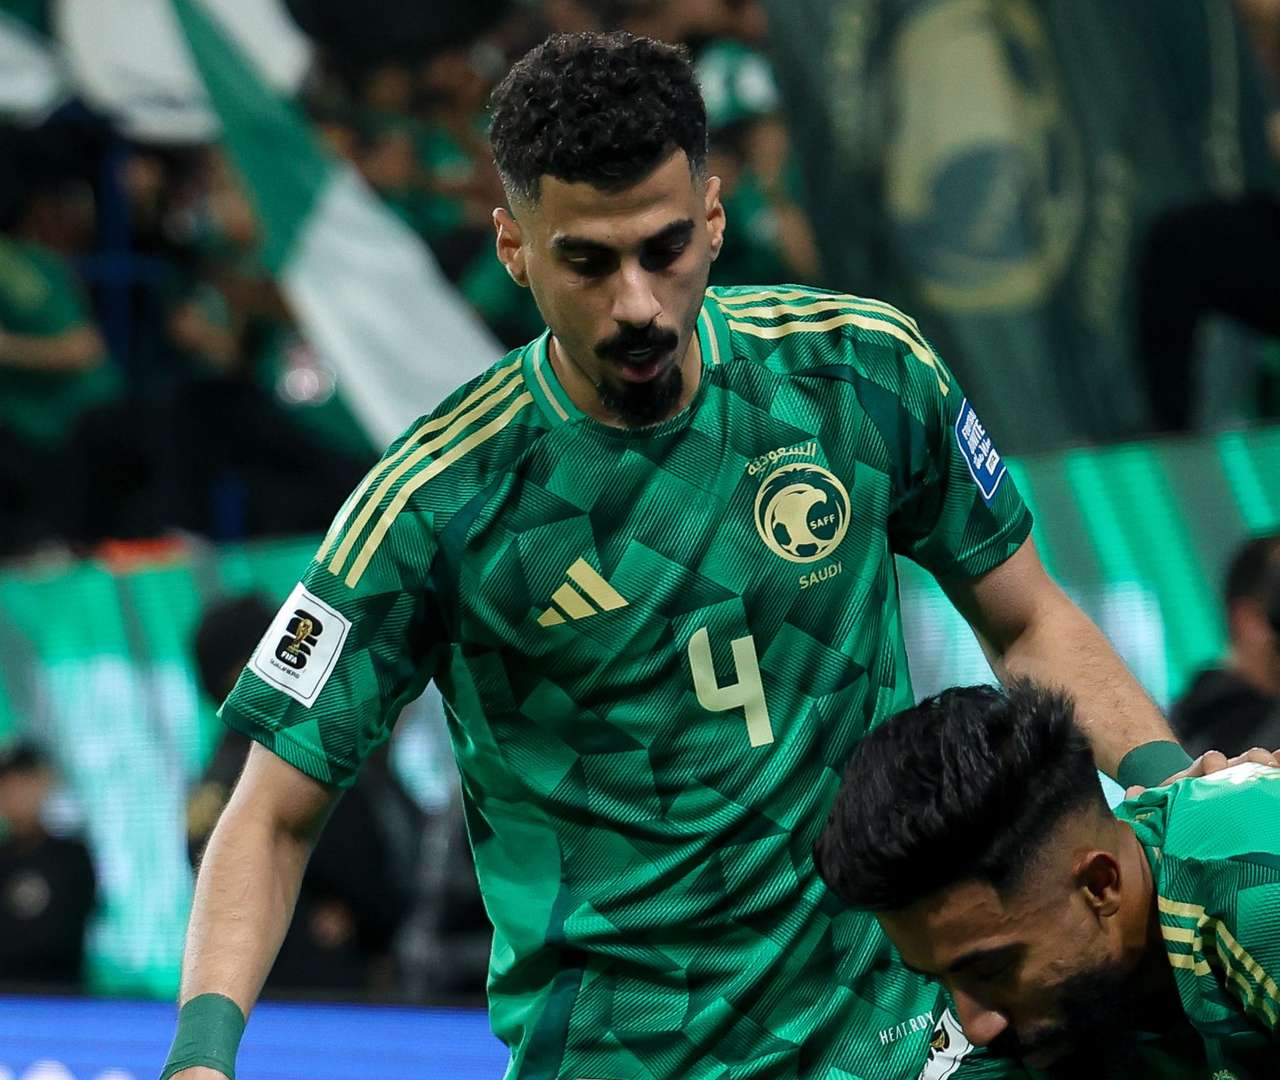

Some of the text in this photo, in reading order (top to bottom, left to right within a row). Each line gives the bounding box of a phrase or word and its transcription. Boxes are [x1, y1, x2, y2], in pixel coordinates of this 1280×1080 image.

[809, 514, 836, 530] SAFF
[798, 560, 843, 590] SAUDI
[281, 651, 298, 664] FIFA
[687, 626, 775, 748] 4
